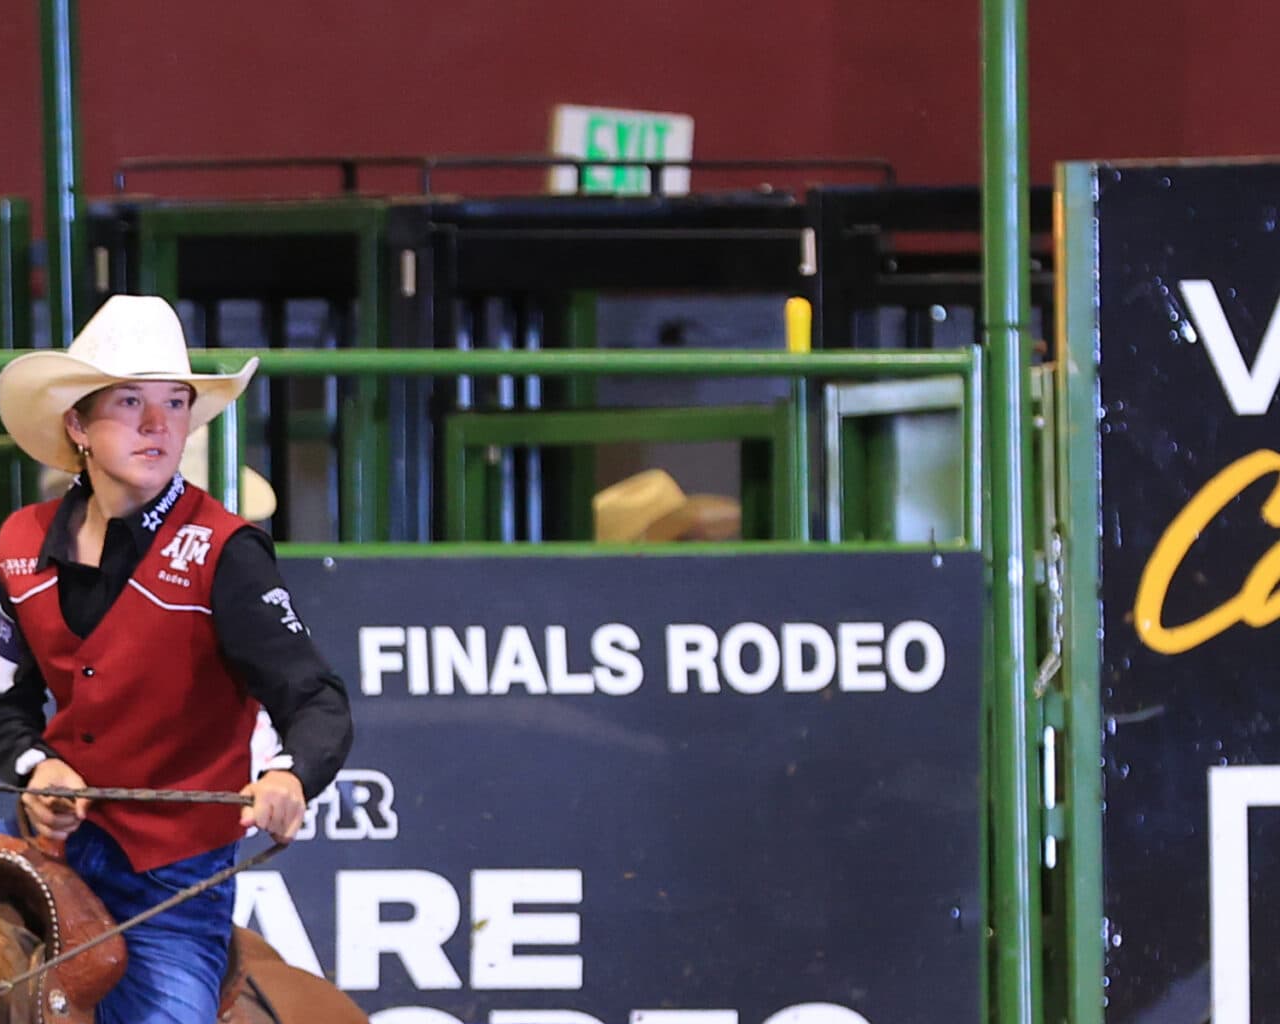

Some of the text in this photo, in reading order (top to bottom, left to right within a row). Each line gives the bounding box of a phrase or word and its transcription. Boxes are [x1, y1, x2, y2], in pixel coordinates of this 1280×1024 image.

[584, 113, 671, 193] EXIT
[155, 471, 185, 514] Wrang
[157, 568, 191, 588] Rodeo
[358, 622, 644, 696] FINALS
[666, 620, 946, 694] RODEO
